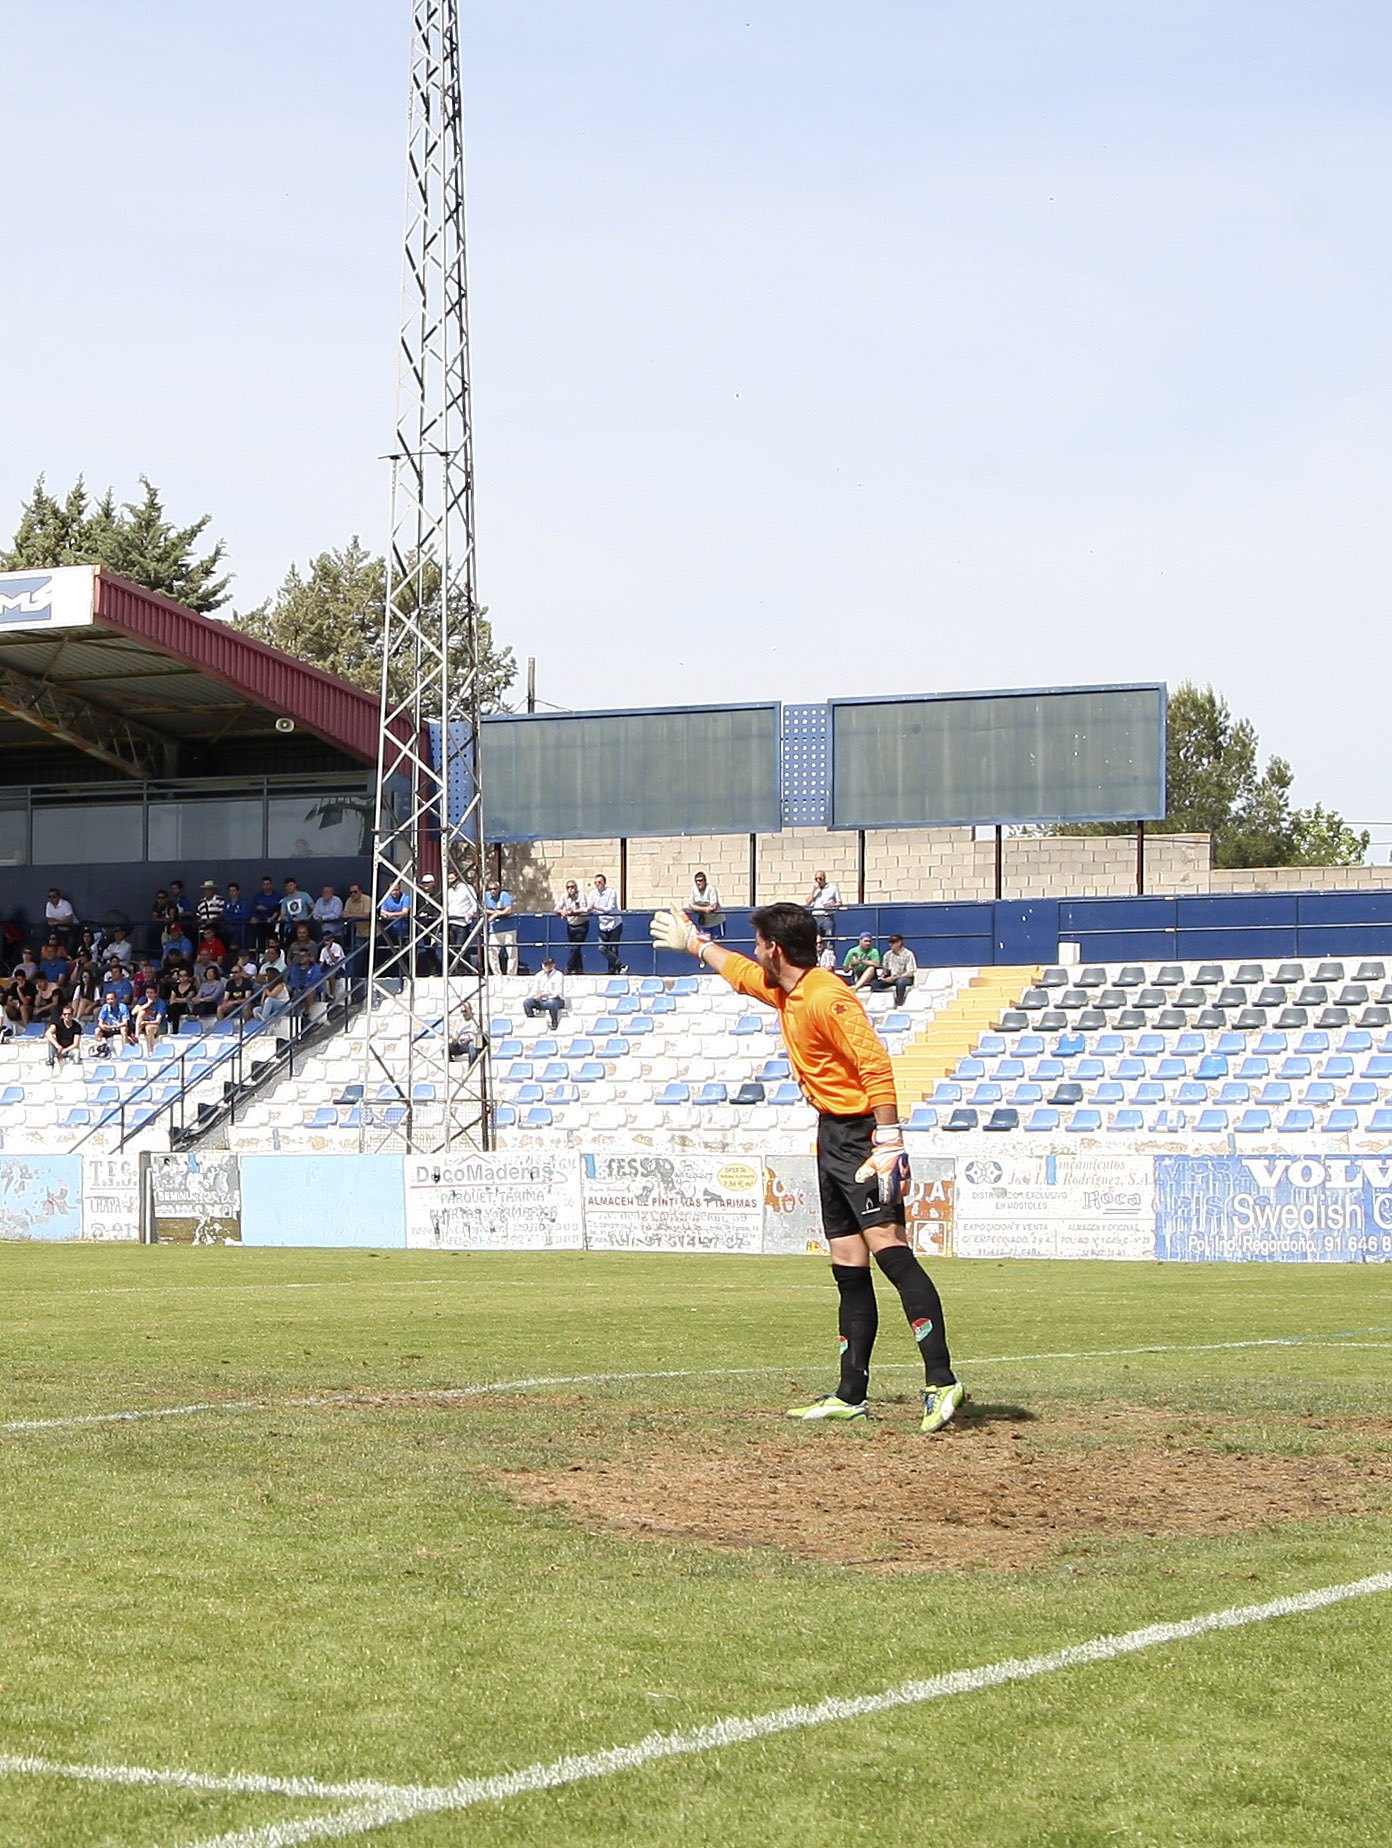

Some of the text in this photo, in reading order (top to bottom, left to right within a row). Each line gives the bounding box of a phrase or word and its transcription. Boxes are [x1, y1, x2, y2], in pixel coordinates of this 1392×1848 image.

[1082, 1190, 1141, 1210] Roca
[1232, 1192, 1363, 1230] Swedish
[1324, 1236, 1343, 1252] 91
[1347, 1236, 1379, 1252] 646
